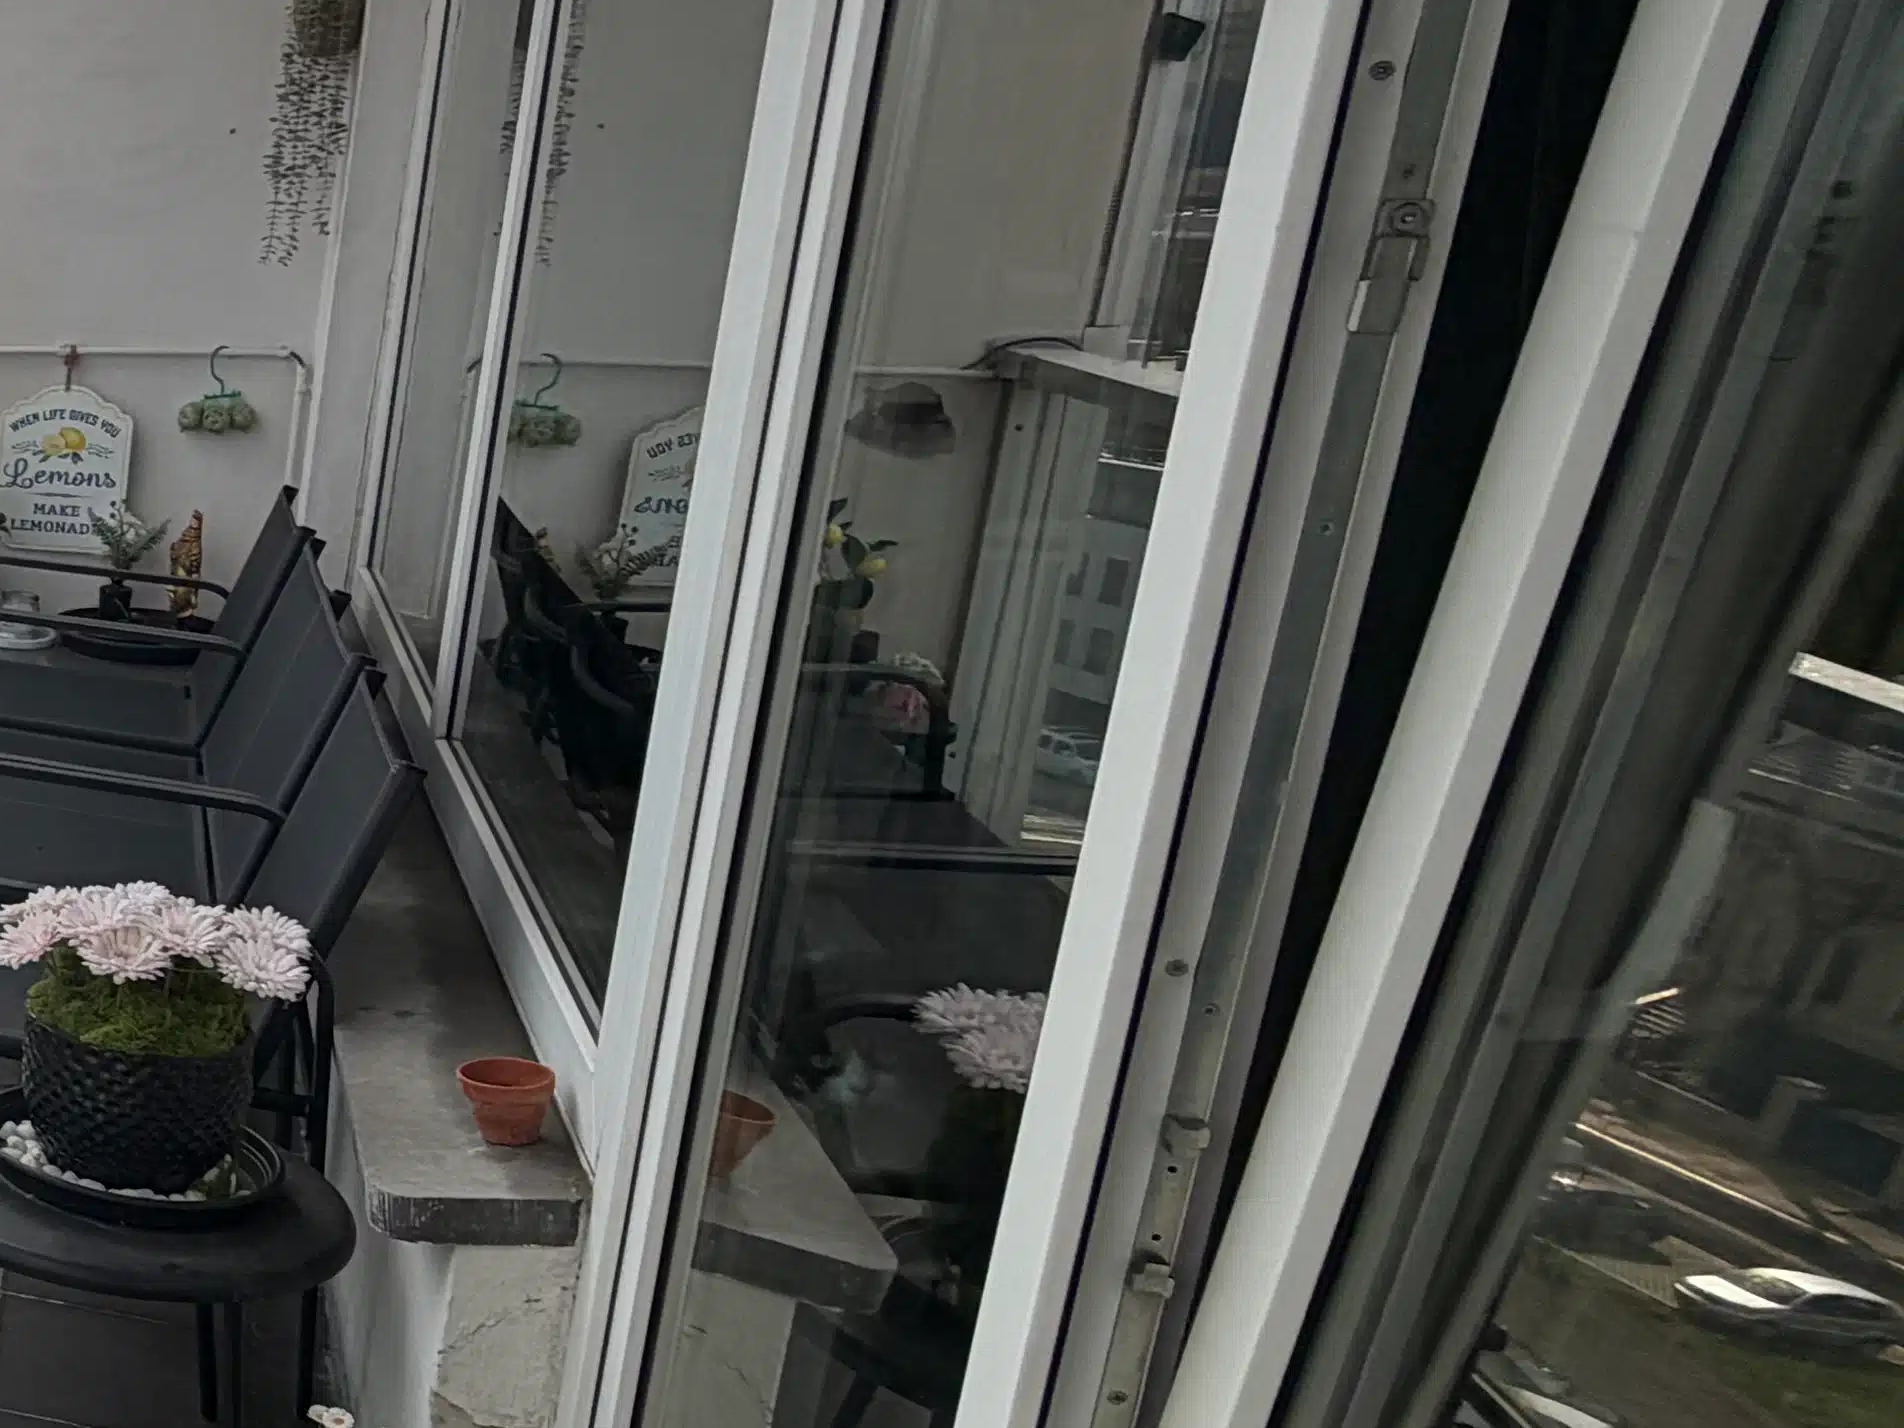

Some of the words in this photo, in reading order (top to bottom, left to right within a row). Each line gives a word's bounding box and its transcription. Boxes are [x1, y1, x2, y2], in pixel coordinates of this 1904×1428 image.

[9, 411, 40, 433] WHEN
[43, 409, 67, 421] LIFE
[68, 409, 100, 426] GIVES
[100, 419, 122, 439] YOU
[3, 458, 117, 489] Lemons
[33, 503, 81, 517] MAKE
